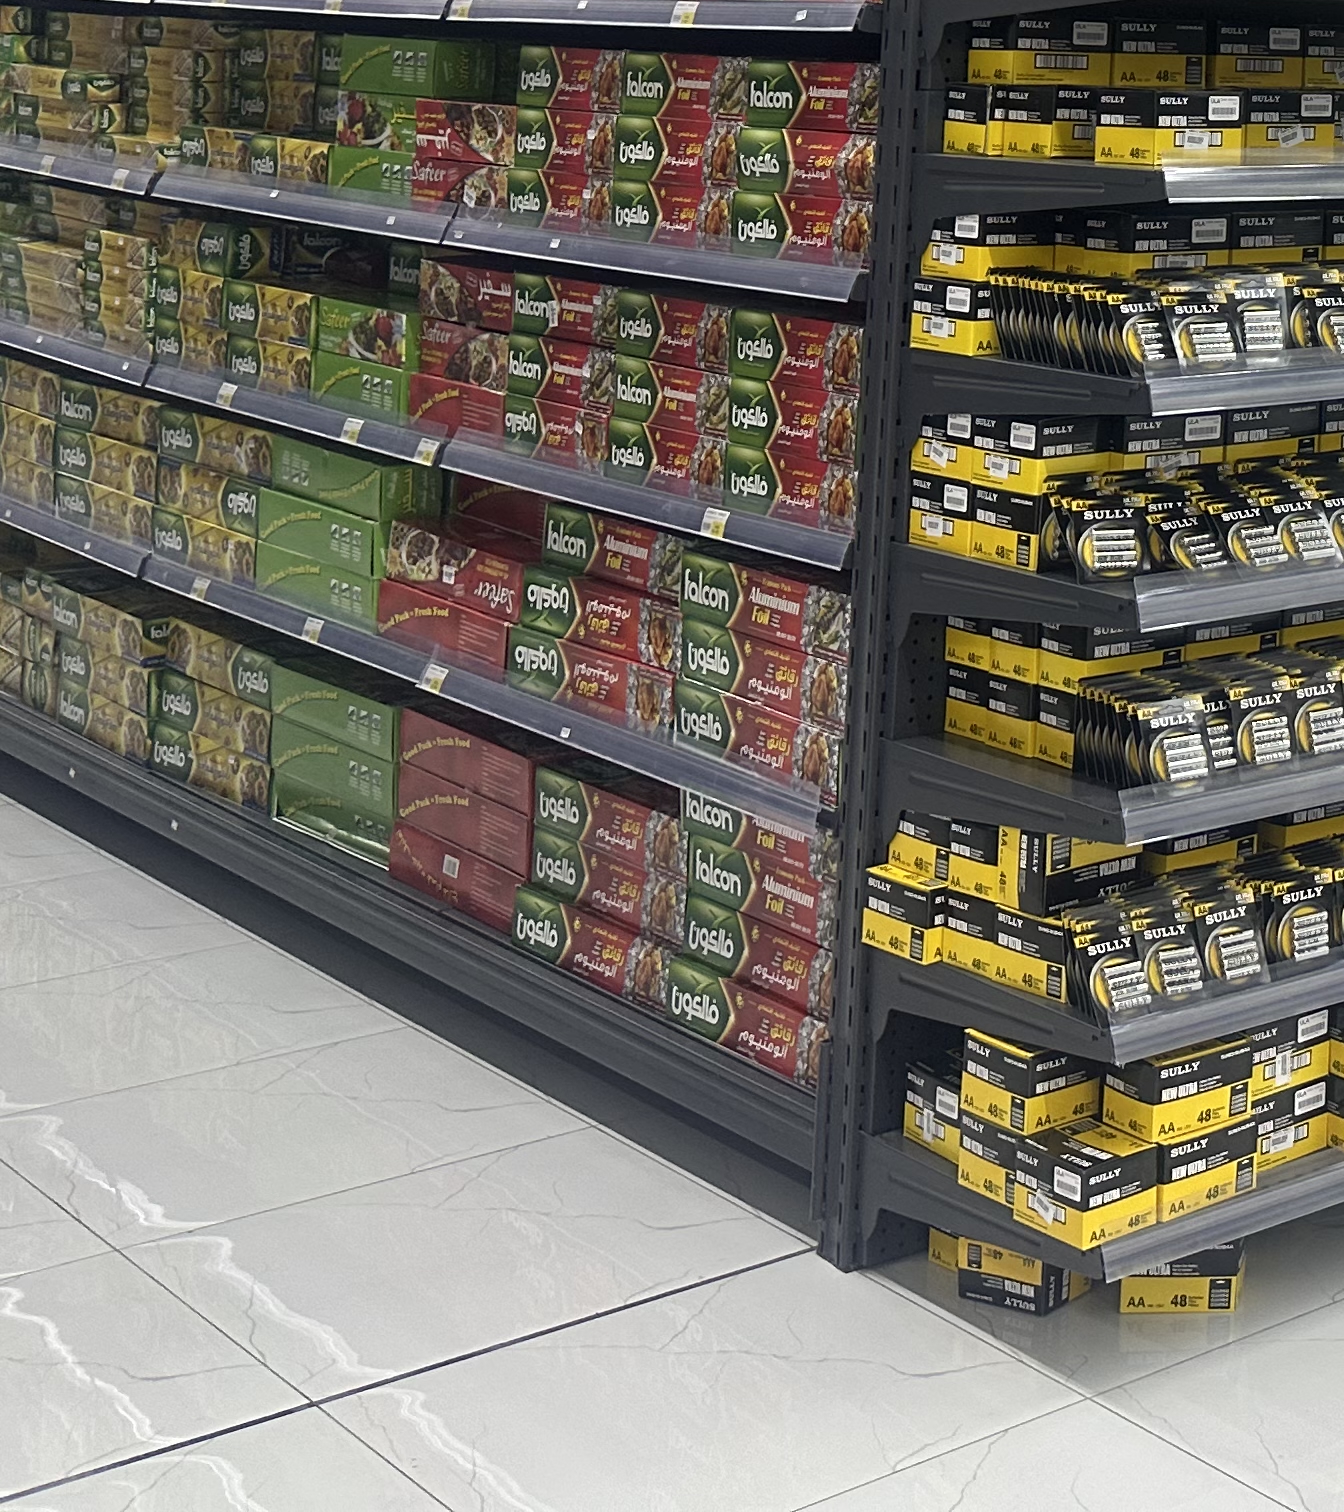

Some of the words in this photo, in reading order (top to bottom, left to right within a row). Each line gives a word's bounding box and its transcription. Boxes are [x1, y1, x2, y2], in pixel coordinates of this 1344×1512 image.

[627, 74, 664, 99] falcon
[750, 83, 794, 110] falcon
[809, 98, 824, 110] Foil
[620, 137, 656, 166] فالكون
[740, 149, 781, 178] فالكون
[477, 273, 512, 300] سفير
[515, 290, 549, 319] falcon
[1174, 304, 1220, 314] SULLY
[421, 320, 451, 345] Safeer
[1083, 508, 1135, 521] SULLY
[547, 518, 587, 559] falcon
[605, 552, 623, 570] Foil
[683, 567, 730, 612] falcon
[748, 586, 801, 617] Aluminium
[751, 606, 770, 625] Foil
[687, 642, 731, 677] فالكون
[1240, 693, 1283, 709] SULLY
[695, 850, 742, 897] falcon
[761, 875, 815, 909] Aluminium
[1282, 886, 1324, 905] SULLY
[764, 894, 785, 916] Foil
[1087, 937, 1132, 956] SULLY
[671, 982, 721, 1026] فالكون
[1160, 1061, 1200, 1080] SULLY
[1158, 1120, 1176, 1137] AA
[1197, 1108, 1212, 1124] 48
[1170, 1138, 1209, 1158] SULLY
[1126, 1295, 1146, 1309] AA
[1170, 1293, 1188, 1308] 48
